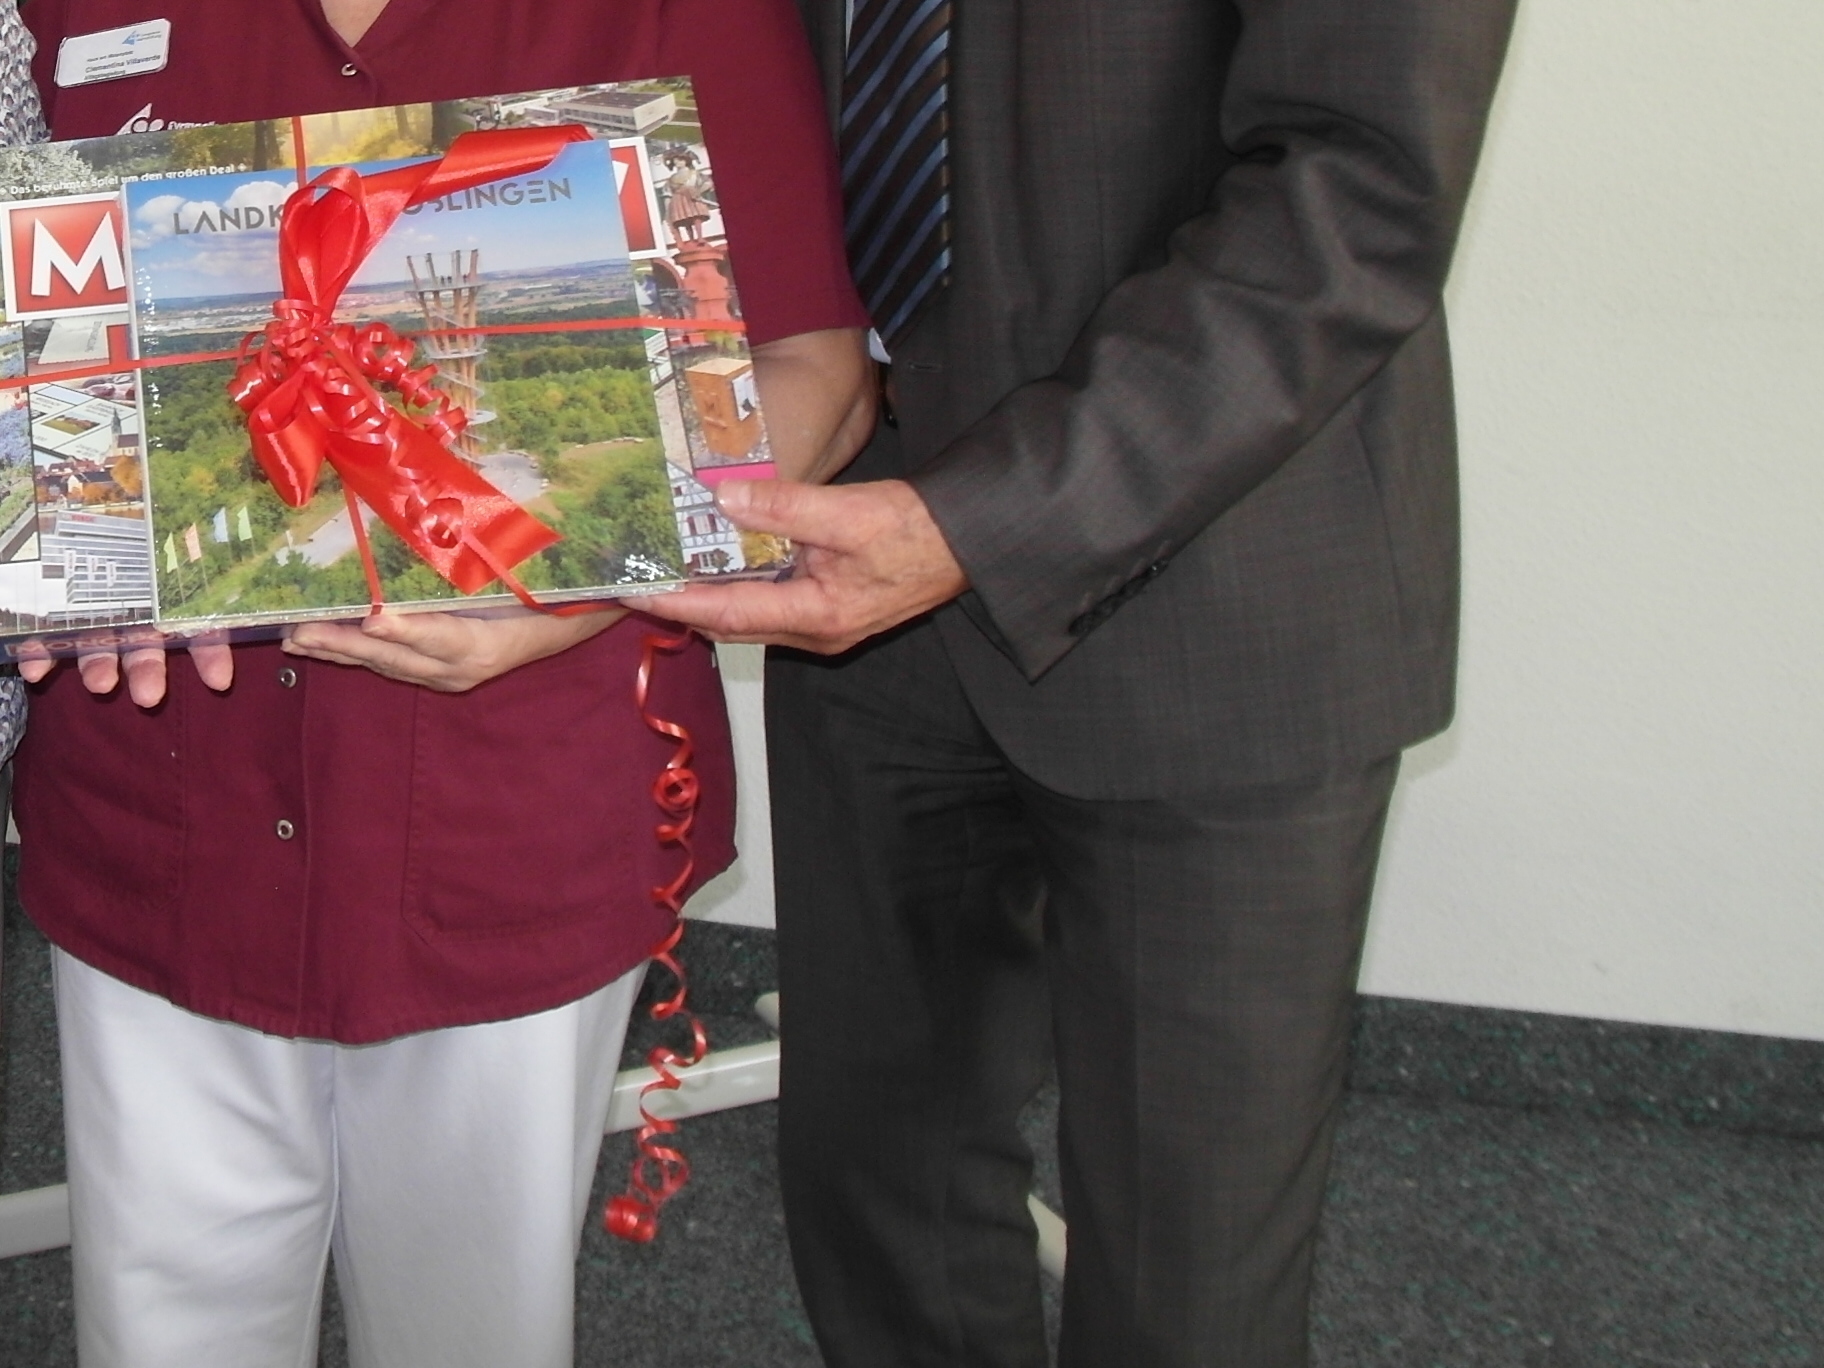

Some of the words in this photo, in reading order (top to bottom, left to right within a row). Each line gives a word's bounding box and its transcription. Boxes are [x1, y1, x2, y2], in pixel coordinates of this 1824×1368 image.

[141, 171, 163, 182] den
[209, 163, 235, 176] Deal
[172, 203, 284, 235] LANDK
